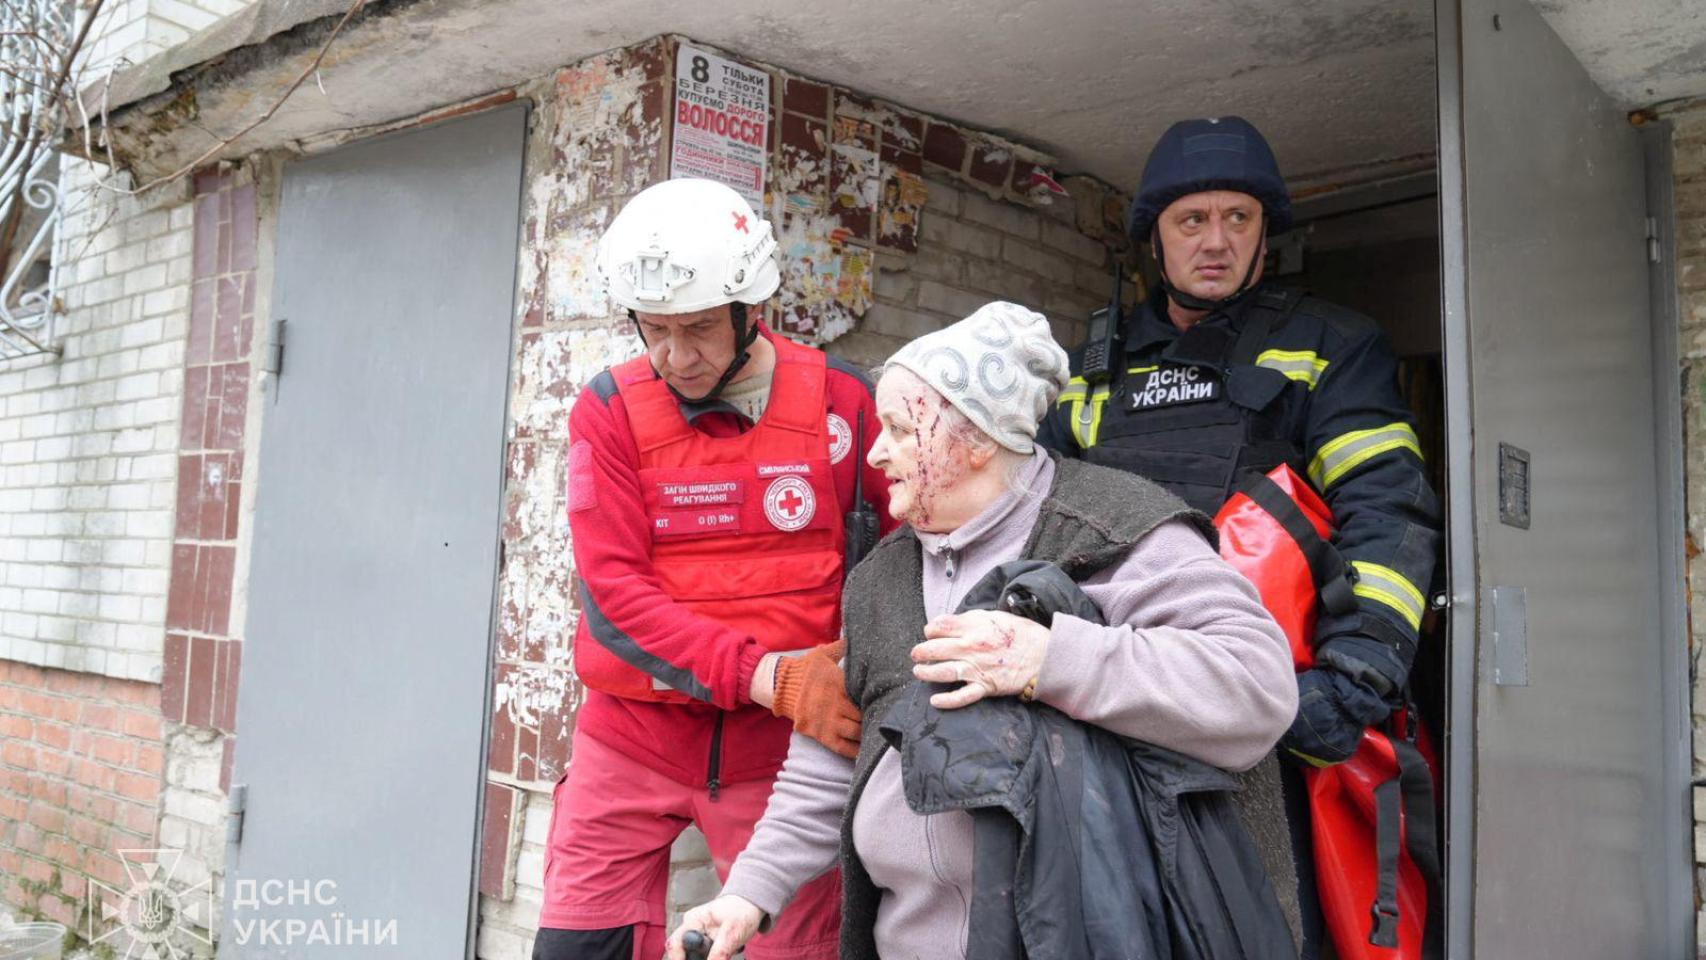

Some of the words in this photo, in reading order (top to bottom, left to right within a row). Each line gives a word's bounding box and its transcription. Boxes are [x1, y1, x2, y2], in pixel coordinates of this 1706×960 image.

[691, 55, 709, 83] 8
[722, 65, 764, 86] ТІЛЬКИ
[679, 78, 765, 112] БЕРЕЗНЯ
[722, 77, 763, 96] СУБОТА
[678, 89, 724, 110] КУПУЄМО
[726, 103, 765, 122] ДОРОГО
[678, 99, 765, 147] ВОЛОССЯ
[1145, 366, 1200, 390] ДСНС
[1132, 381, 1213, 408] УКРАЇНИ
[663, 485, 687, 495] ЗАГІН
[689, 482, 736, 494] ШВИДКОГО
[673, 494, 727, 504] РЕАГУВАННЯ
[719, 514, 734, 524] Rh+
